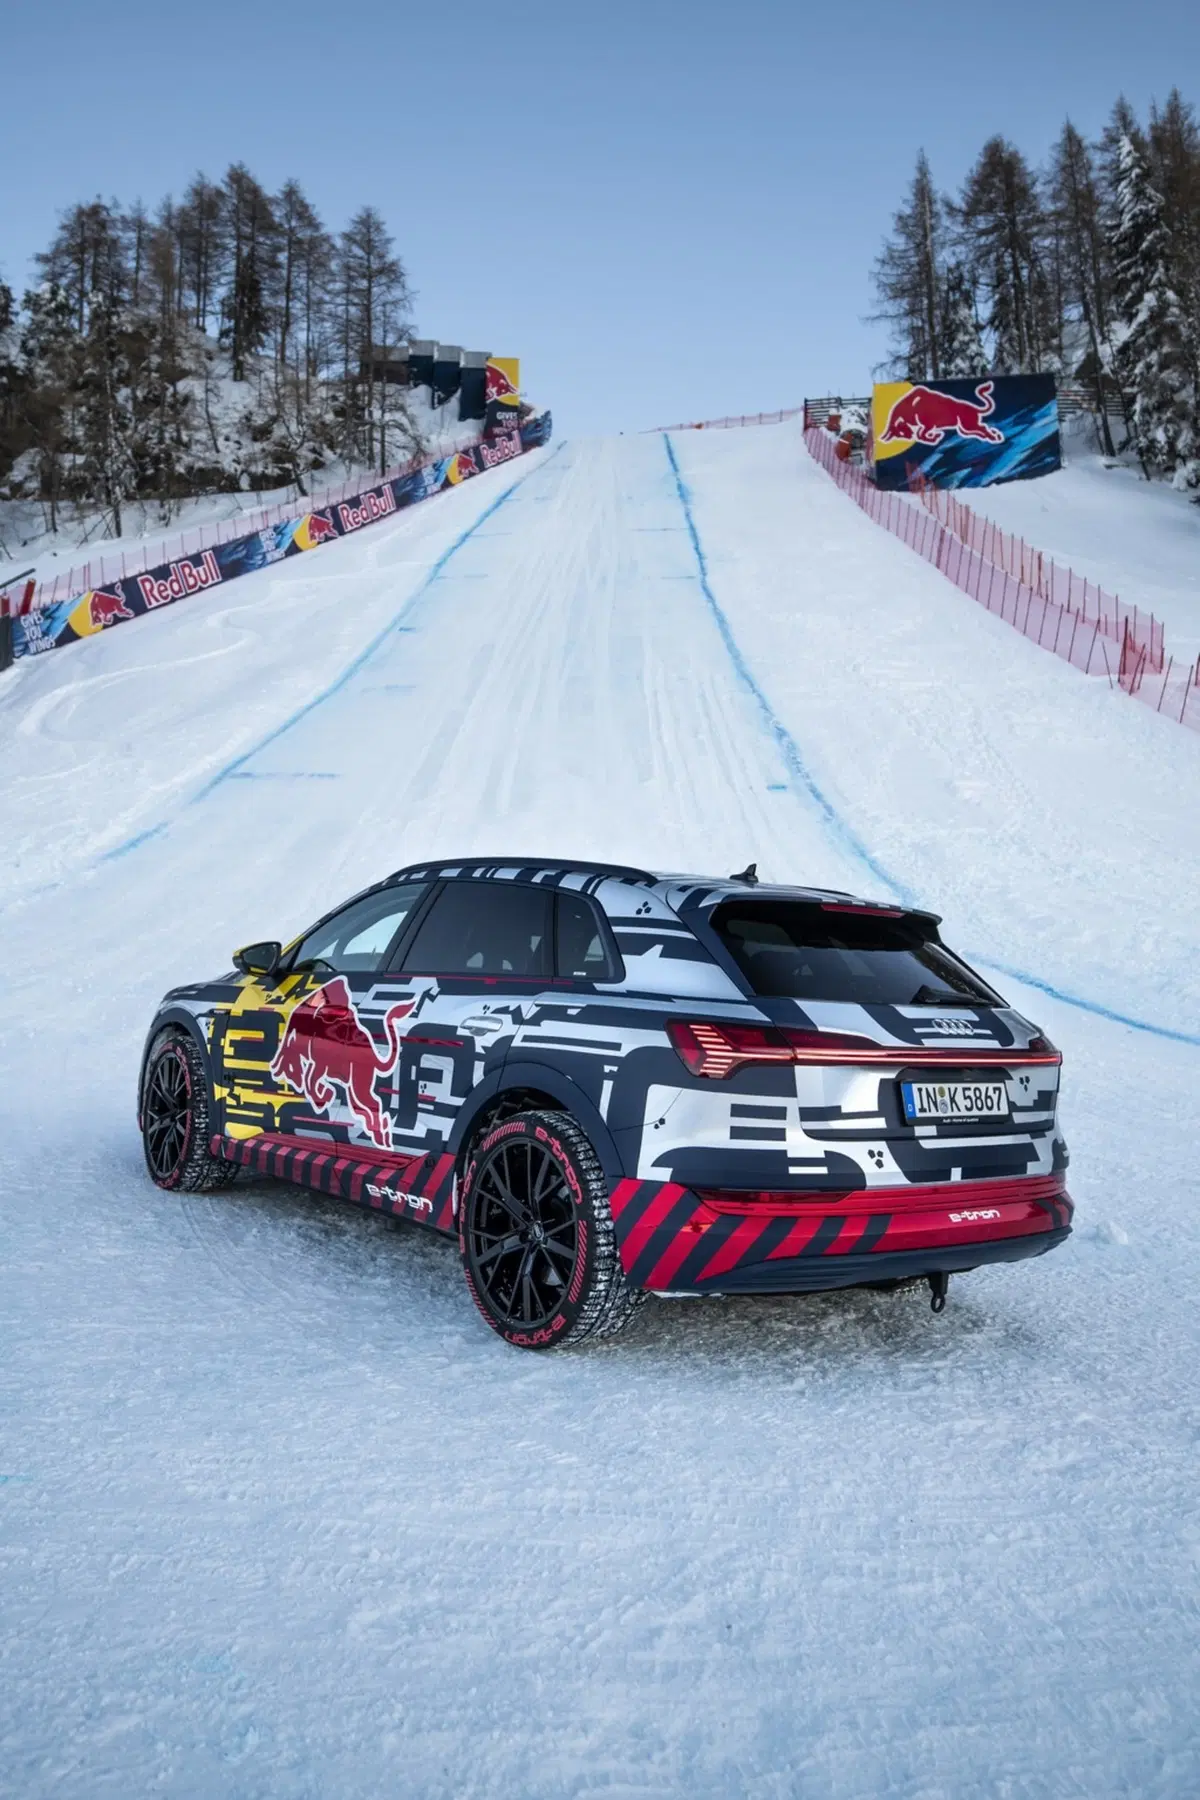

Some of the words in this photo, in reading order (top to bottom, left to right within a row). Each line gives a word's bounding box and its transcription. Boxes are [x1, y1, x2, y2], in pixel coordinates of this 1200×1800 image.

[479, 437, 502, 468] Red
[499, 429, 523, 459] Bull
[337, 494, 371, 532] Red
[367, 483, 397, 521] Bull
[137, 563, 185, 609] Red
[180, 550, 223, 593] Bull
[917, 1087, 939, 1113] IN
[948, 1087, 961, 1112] K
[962, 1086, 1002, 1112] 5867
[535, 1127, 583, 1205] e-tron
[364, 1183, 433, 1213] e-tron
[948, 1209, 1001, 1222] e-tron
